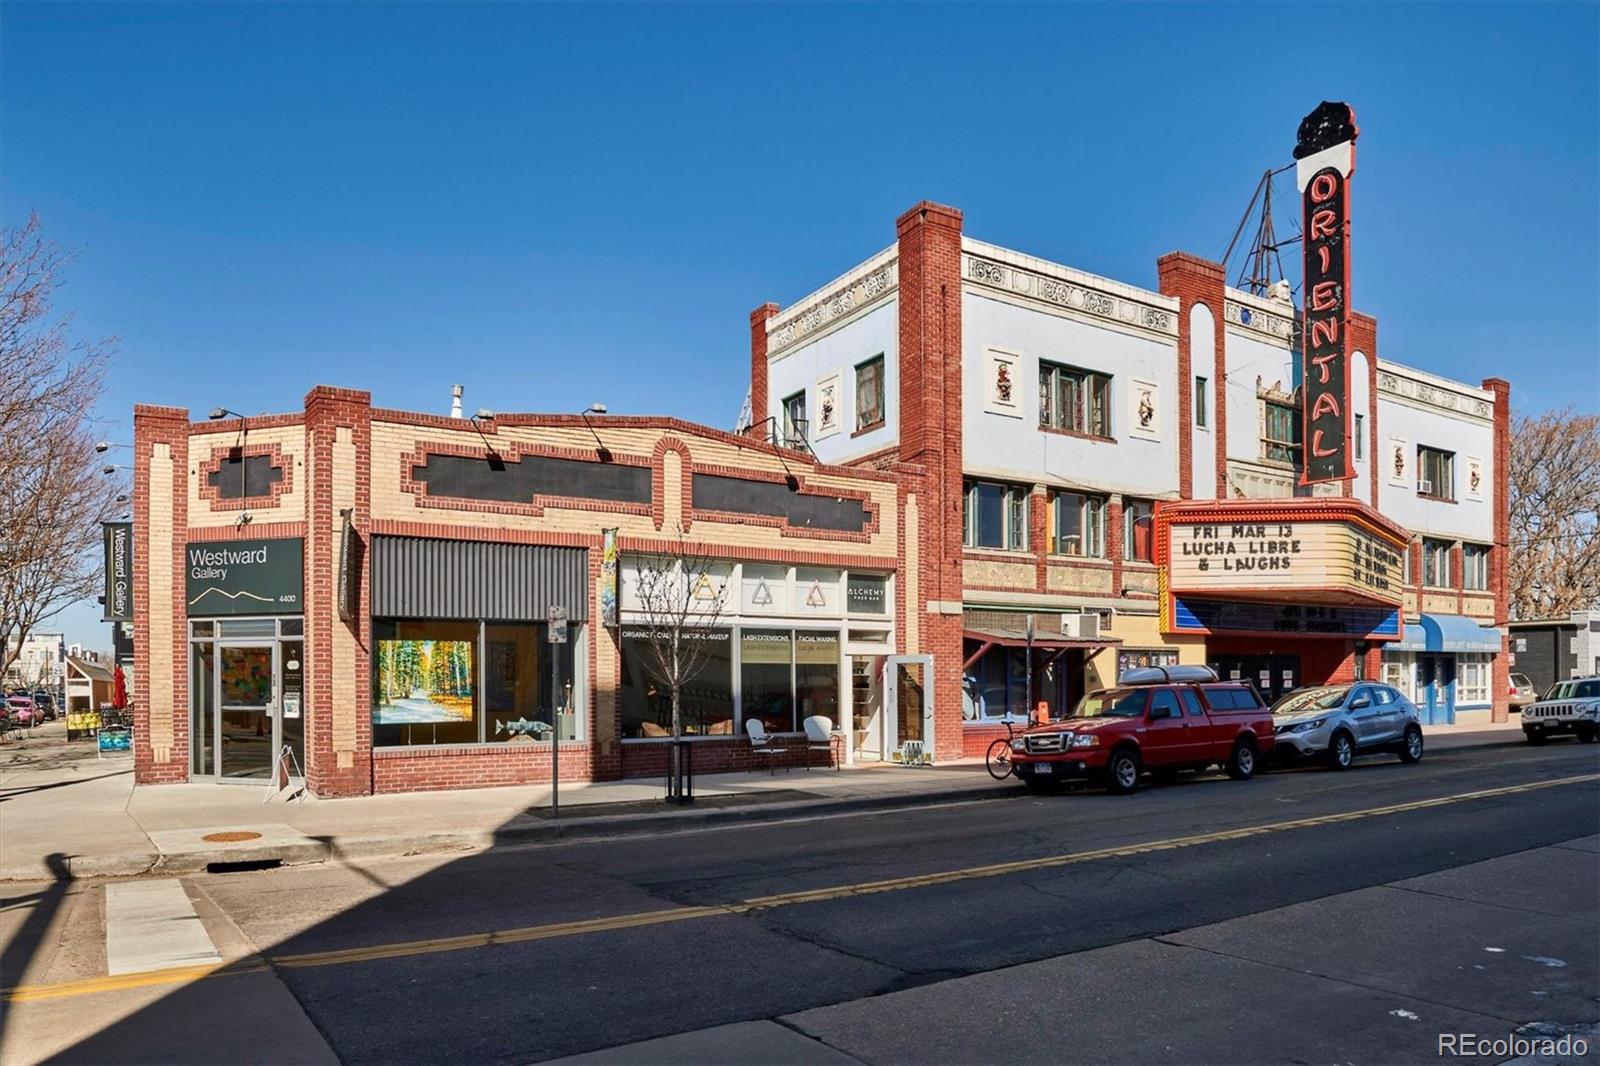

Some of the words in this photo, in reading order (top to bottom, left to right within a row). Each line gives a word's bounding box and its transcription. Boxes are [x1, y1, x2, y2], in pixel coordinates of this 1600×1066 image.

[1310, 172, 1340, 458] ORIENTAL
[1193, 526, 1218, 539] FRI
[1231, 525, 1266, 538] MAR
[1278, 525, 1293, 538] 13
[114, 528, 126, 577] Westward
[342, 521, 350, 571] Westward
[1182, 541, 1237, 556] LUCHA
[1249, 539, 1301, 554] LIBRE
[189, 545, 267, 566] Westward
[1198, 557, 1209, 571] &
[1223, 556, 1291, 572] LAUGHS
[191, 566, 228, 581] Gallery
[113, 581, 127, 616] Gallery
[279, 594, 296, 603] 4400
[848, 588, 884, 596] ALCHEMY
[650, 631, 672, 640] FCIAL
